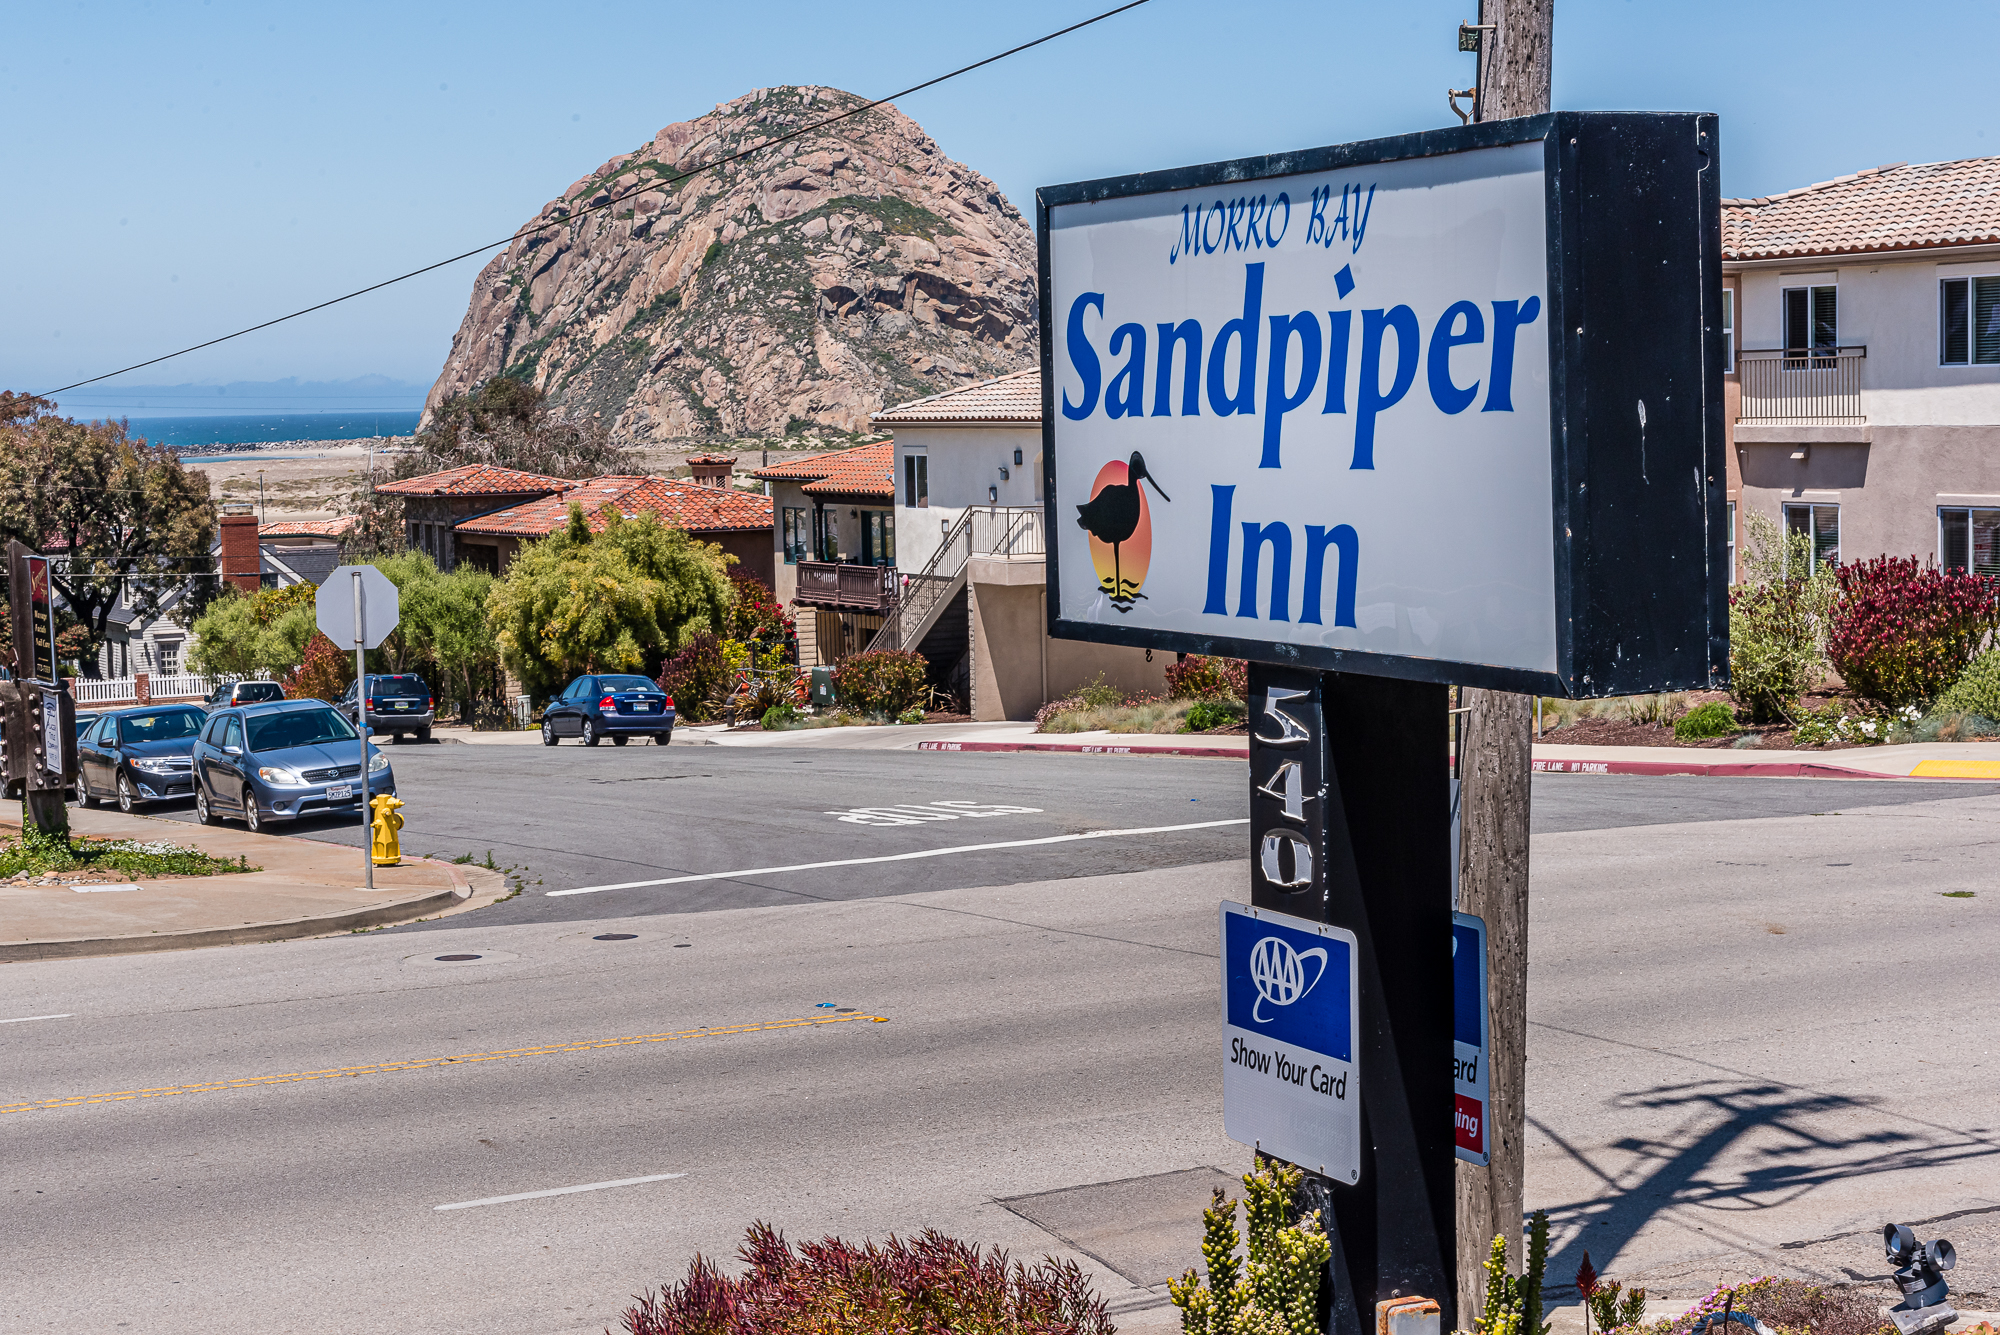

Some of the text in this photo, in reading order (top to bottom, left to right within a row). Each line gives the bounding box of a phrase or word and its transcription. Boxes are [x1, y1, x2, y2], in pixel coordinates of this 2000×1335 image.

[1170, 182, 1377, 264] MORRO BAY
[1062, 262, 1541, 470] Sandpiper
[1202, 484, 1359, 628] Inn
[1532, 761, 1546, 771] FIRE
[1547, 762, 1564, 772] LANE
[1581, 763, 1608, 774] PARKING
[1231, 1037, 1348, 1100] Show Your Card
[1454, 1055, 1478, 1084] ard
